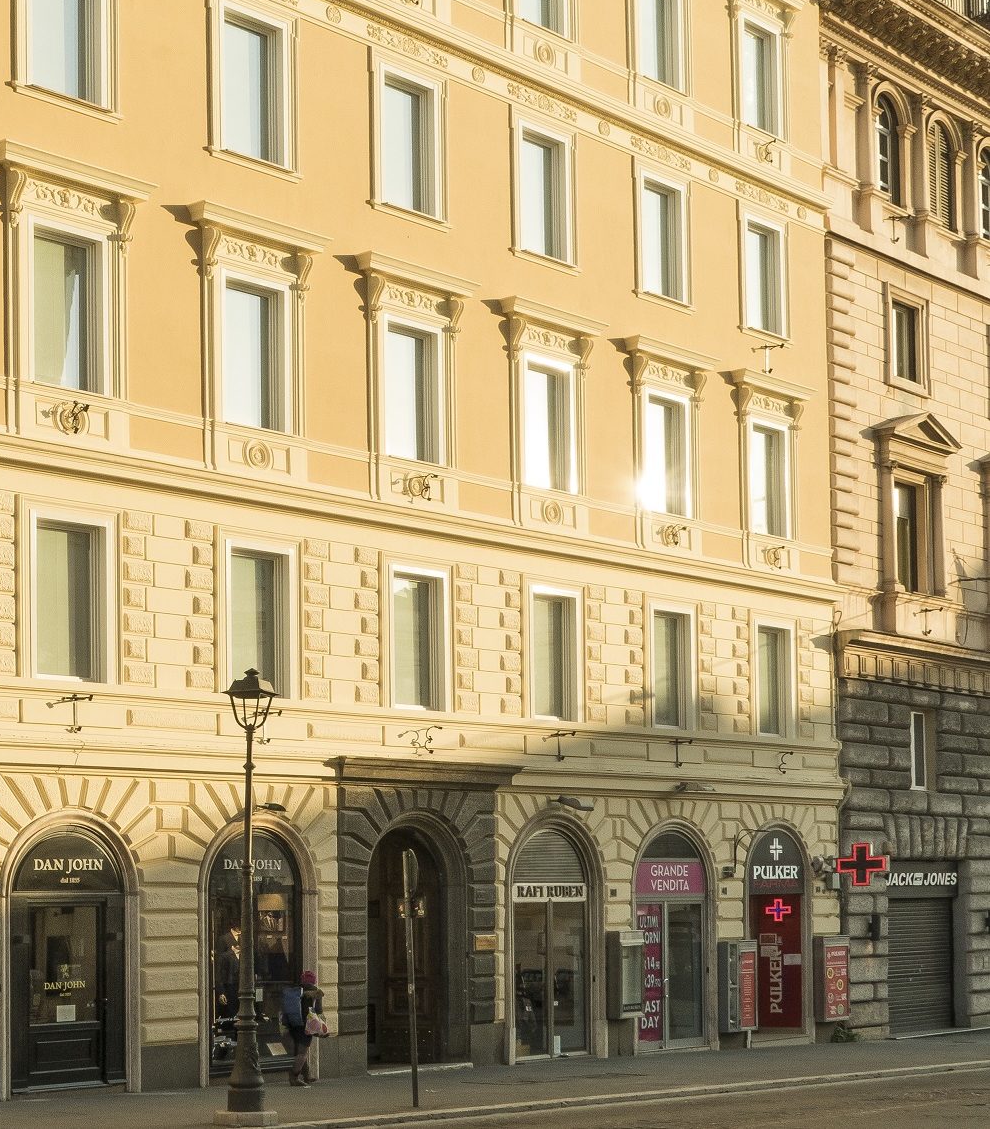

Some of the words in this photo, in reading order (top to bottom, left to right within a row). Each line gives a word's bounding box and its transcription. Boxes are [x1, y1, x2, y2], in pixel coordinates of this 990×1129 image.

[33, 858, 64, 871] DAN
[66, 858, 104, 874] JOHN
[223, 859, 245, 870] DA
[650, 864, 689, 877] GRANDE
[753, 865, 799, 880] PULKER
[885, 872, 914, 886] JACK
[923, 872, 957, 886] JONES
[517, 885, 544, 898] RAFI
[546, 885, 584, 898] RUBEN
[650, 879, 690, 891] VENDITA
[644, 931, 661, 944] ORNI
[44, 981, 62, 990] DAN
[62, 980, 86, 991] JOHN
[644, 1000, 661, 1013] AST
[641, 1015, 660, 1029] DAY
